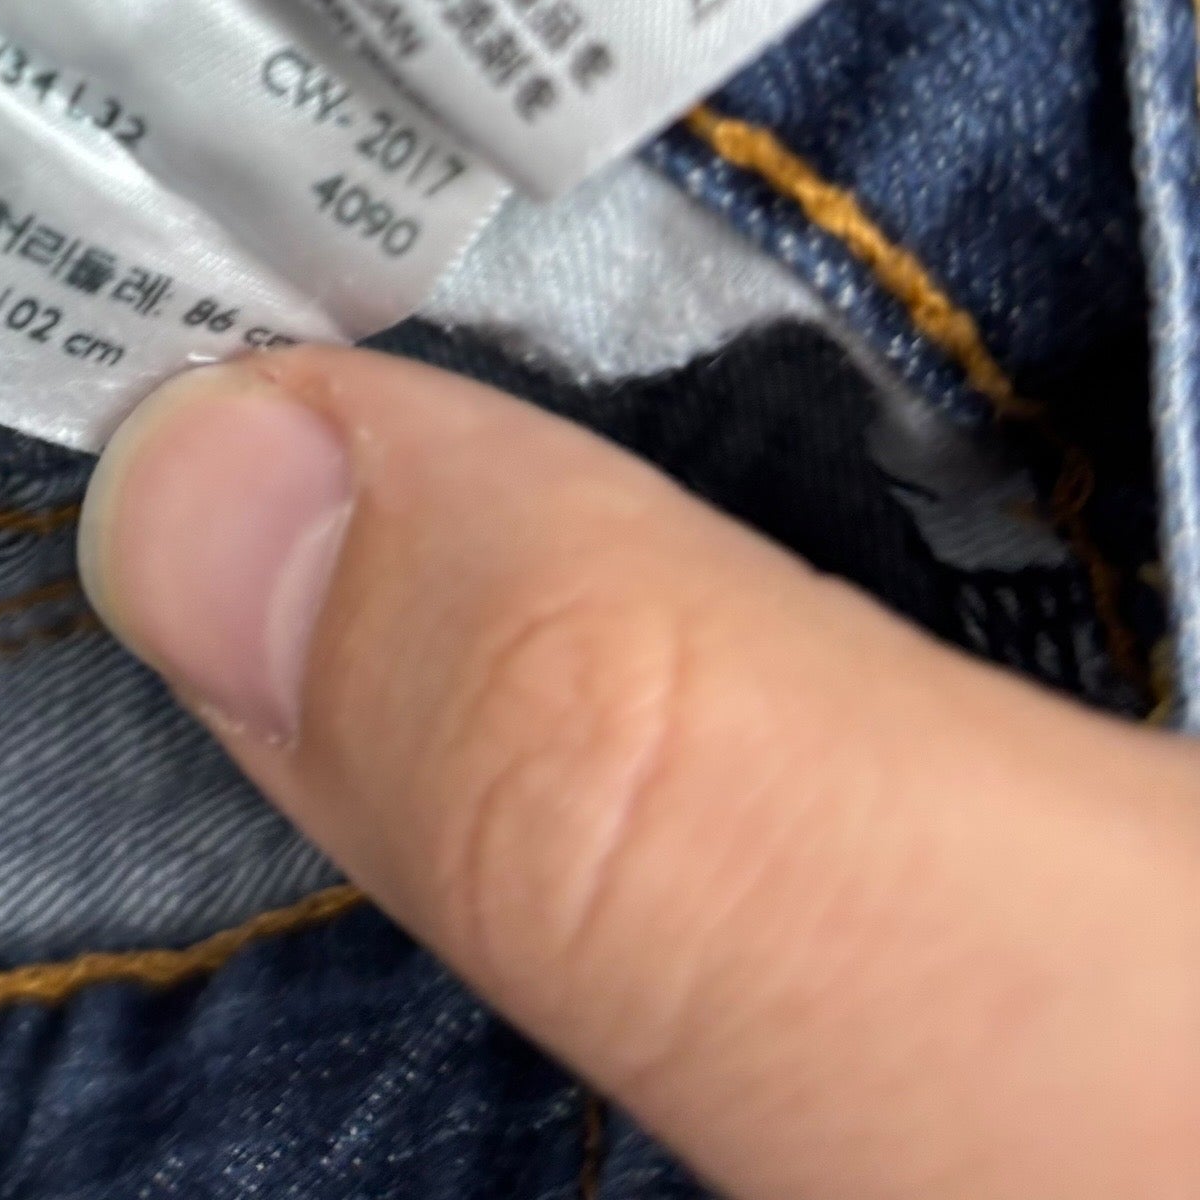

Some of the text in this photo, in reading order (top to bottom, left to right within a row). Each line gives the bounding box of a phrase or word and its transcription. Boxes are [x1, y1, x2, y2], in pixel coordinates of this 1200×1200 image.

[353, 106, 468, 198] 2017
[312, 175, 424, 261] 4090
[182, 298, 241, 334] 86
[60, 329, 126, 369] cm
